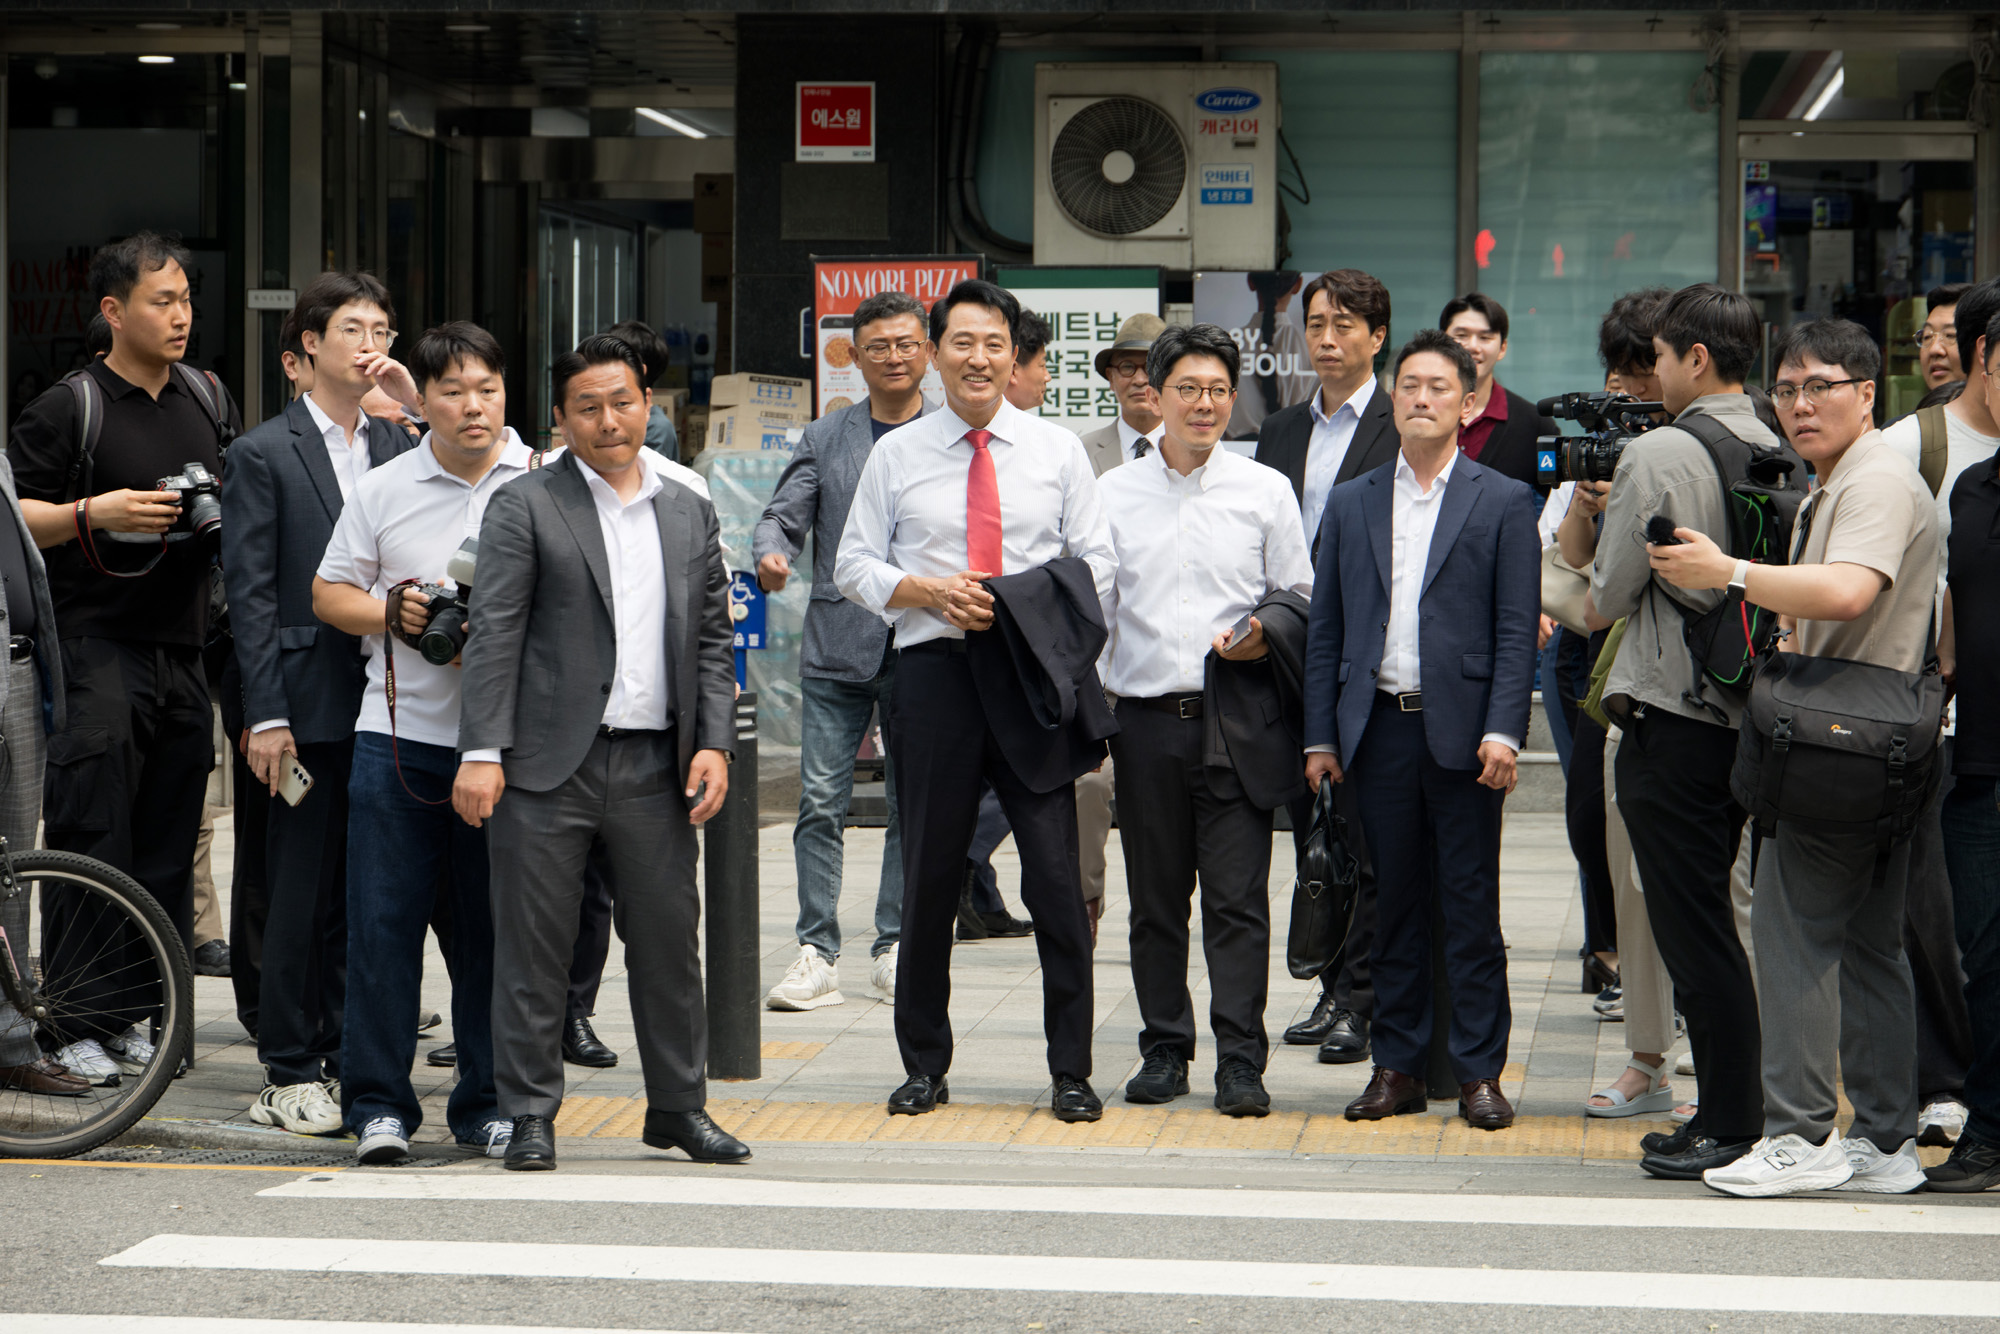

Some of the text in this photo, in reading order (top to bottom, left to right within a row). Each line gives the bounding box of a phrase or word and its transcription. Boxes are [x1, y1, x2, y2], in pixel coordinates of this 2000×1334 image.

[1204, 94, 1253, 107] Carrier
[811, 108, 861, 130] 에스원
[1199, 119, 1259, 135] 캐리어
[1205, 170, 1249, 184] 인버터
[820, 269, 849, 298] NO
[1045, 349, 1091, 379] 쌀국
[1038, 387, 1120, 417] 전문점
[386, 669, 395, 708] Canon
